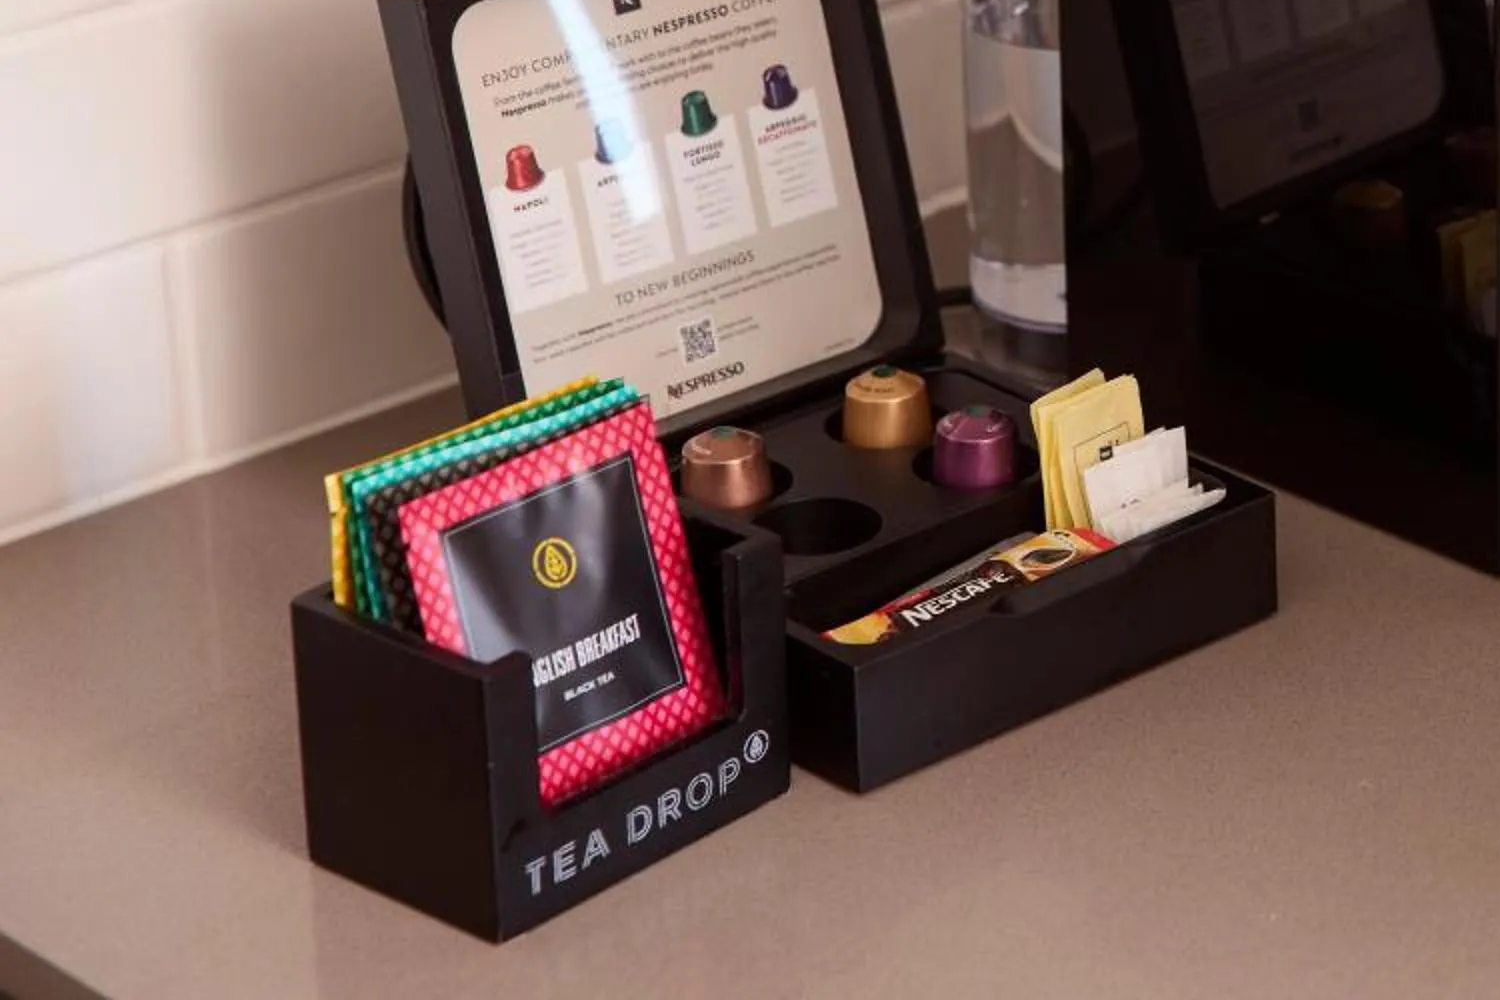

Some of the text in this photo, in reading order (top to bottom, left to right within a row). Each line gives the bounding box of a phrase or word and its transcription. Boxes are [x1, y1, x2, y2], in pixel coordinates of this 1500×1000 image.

[481, 64, 527, 88] ENJOY
[653, 5, 729, 36] NESPRESSO
[615, 250, 755, 306] TO NEW BEGINNINGS
[667, 361, 745, 399] NESPRESSO
[576, 613, 640, 667] BREAKFAST
[564, 680, 596, 701] BLACK
[525, 761, 741, 896] TEA DROP
